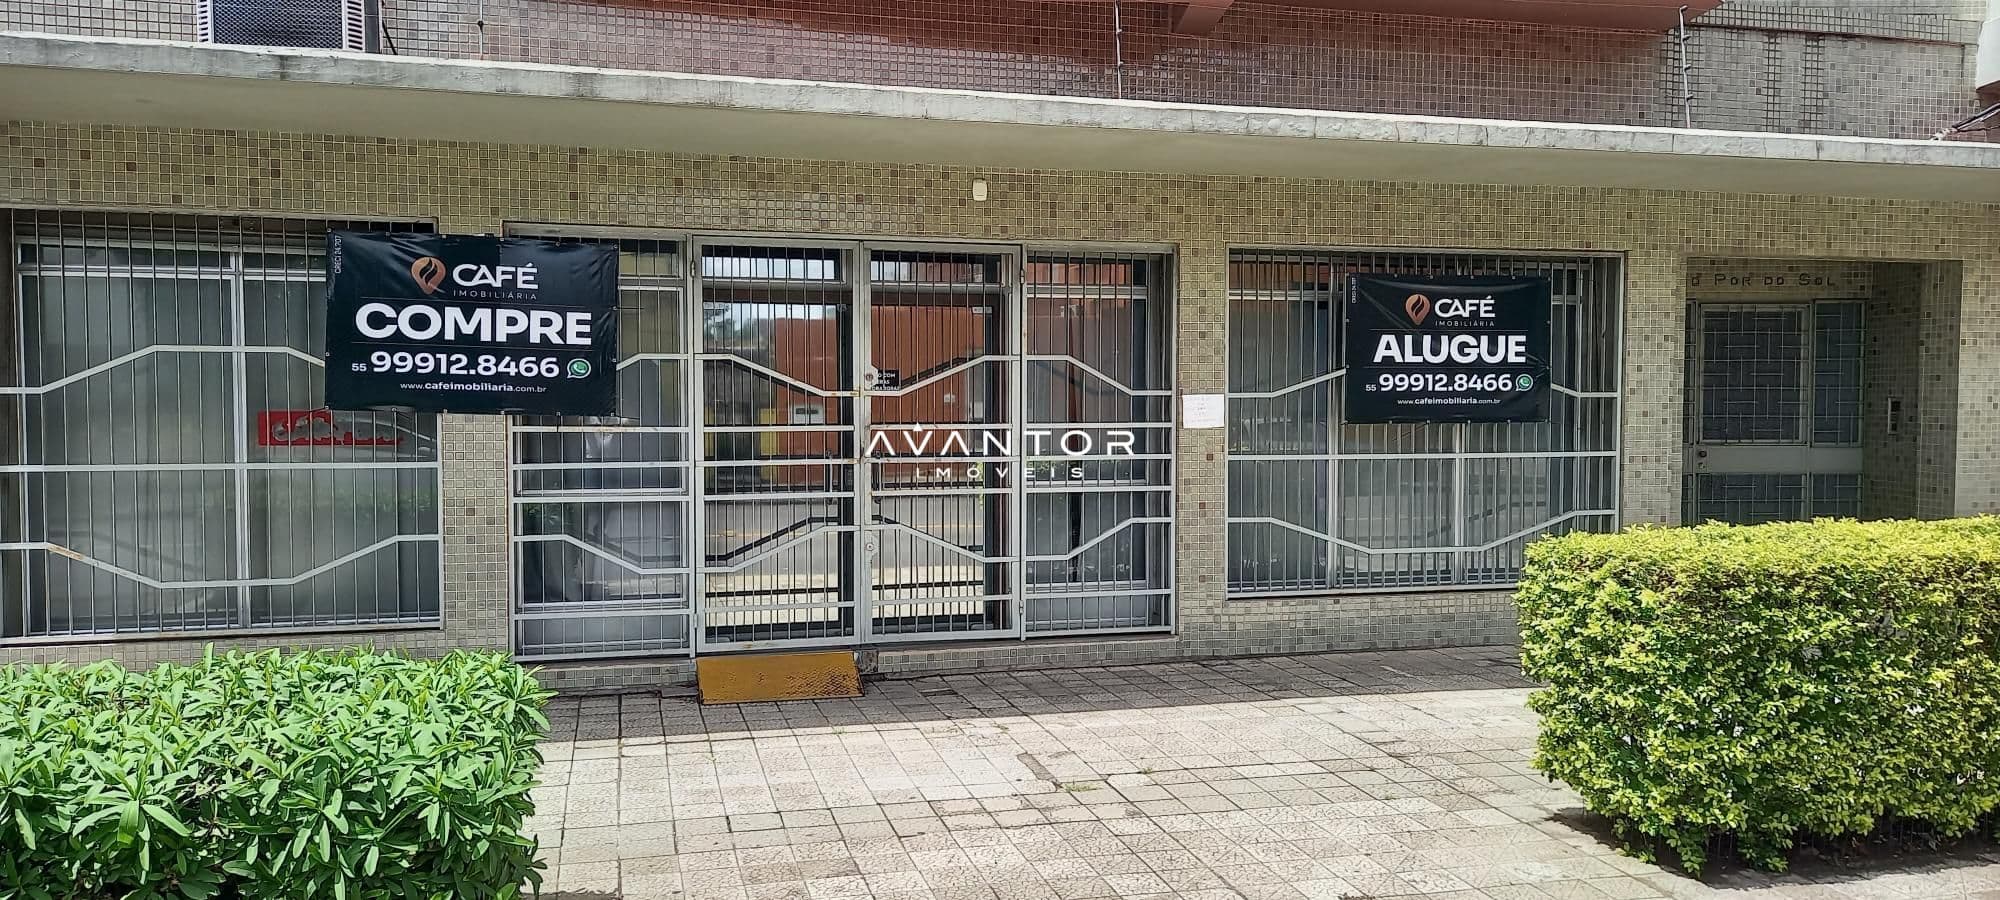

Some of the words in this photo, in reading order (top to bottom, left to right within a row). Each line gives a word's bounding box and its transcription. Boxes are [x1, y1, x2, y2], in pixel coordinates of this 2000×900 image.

[452, 262, 539, 289] CAFÉ
[453, 289, 537, 300] IMOBILIÁRIA
[1434, 295, 1496, 318] CAFÉ
[355, 303, 592, 345] COMPRE
[1372, 334, 1526, 363] ALUGUE
[351, 362, 367, 372] 55
[370, 350, 560, 378] 99912.8466
[400, 380, 548, 393] www.cafeimobiliaria.com.br
[1365, 384, 1377, 392] 55
[1378, 373, 1513, 392] 99912.8466
[1397, 397, 1501, 405] www.cafeimobiliaria.com.br
